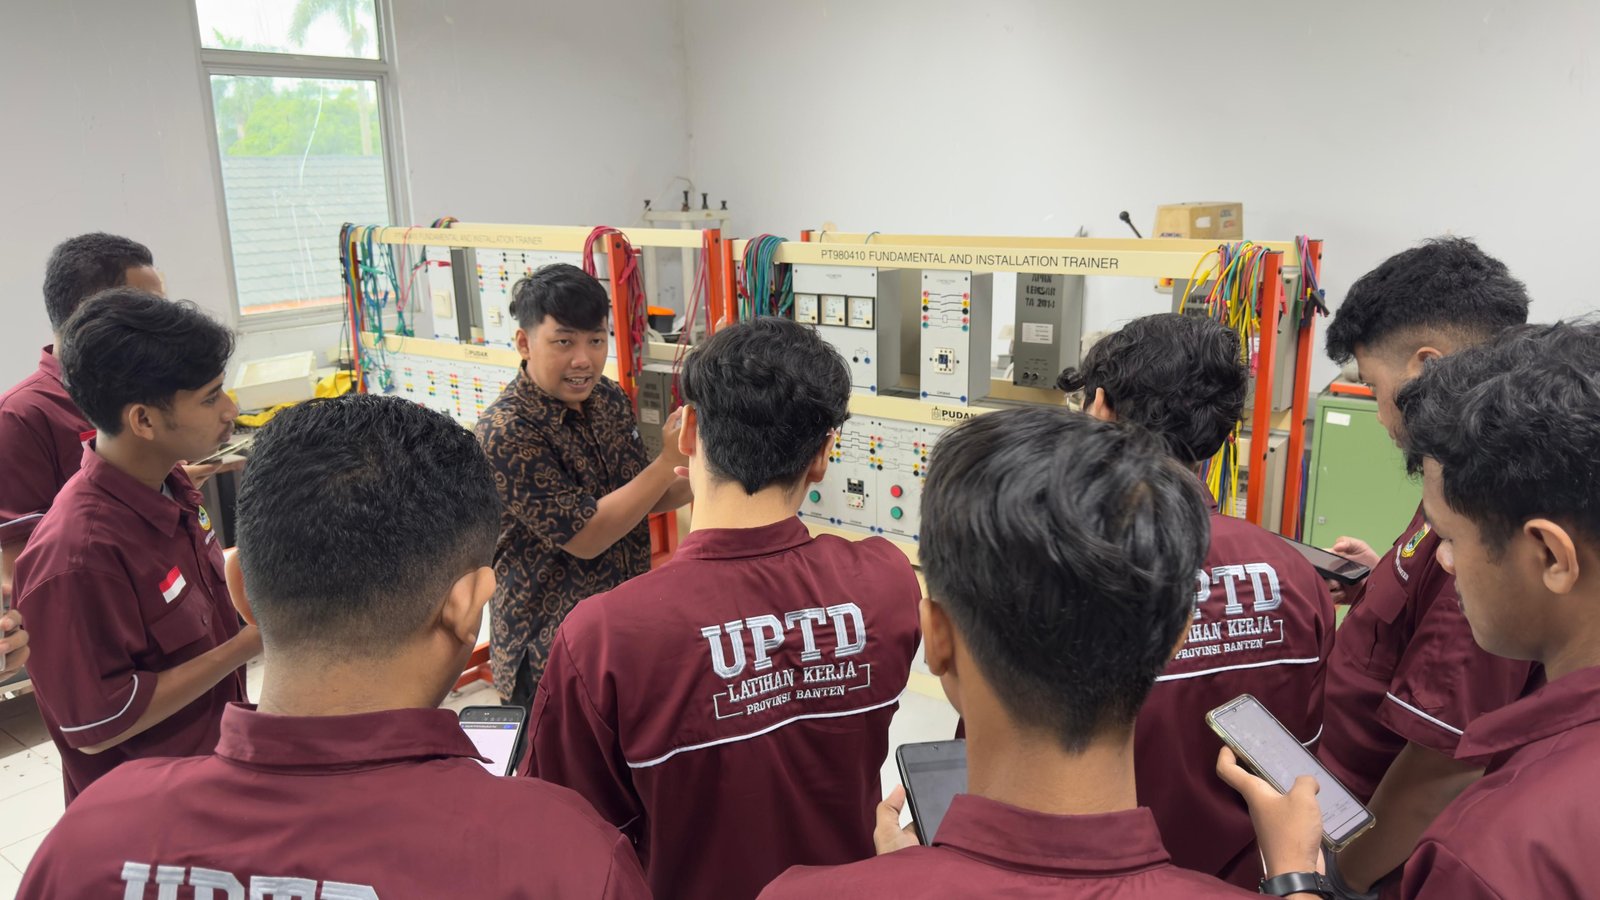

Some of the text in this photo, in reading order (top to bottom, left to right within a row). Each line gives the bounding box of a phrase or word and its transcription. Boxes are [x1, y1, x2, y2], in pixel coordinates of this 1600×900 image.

[821, 249, 1119, 269] PT980410 FUNDAMENTAL AND INSTALLATION TRAINER
[1192, 562, 1282, 620] PTD
[701, 602, 867, 679] UPTD
[1187, 616, 1273, 643] IHAN KERJA
[1224, 639, 1263, 652] BANTEN
[728, 661, 857, 703] LATIHAN KERJA
[746, 685, 845, 715] PROVINSI BANTEN
